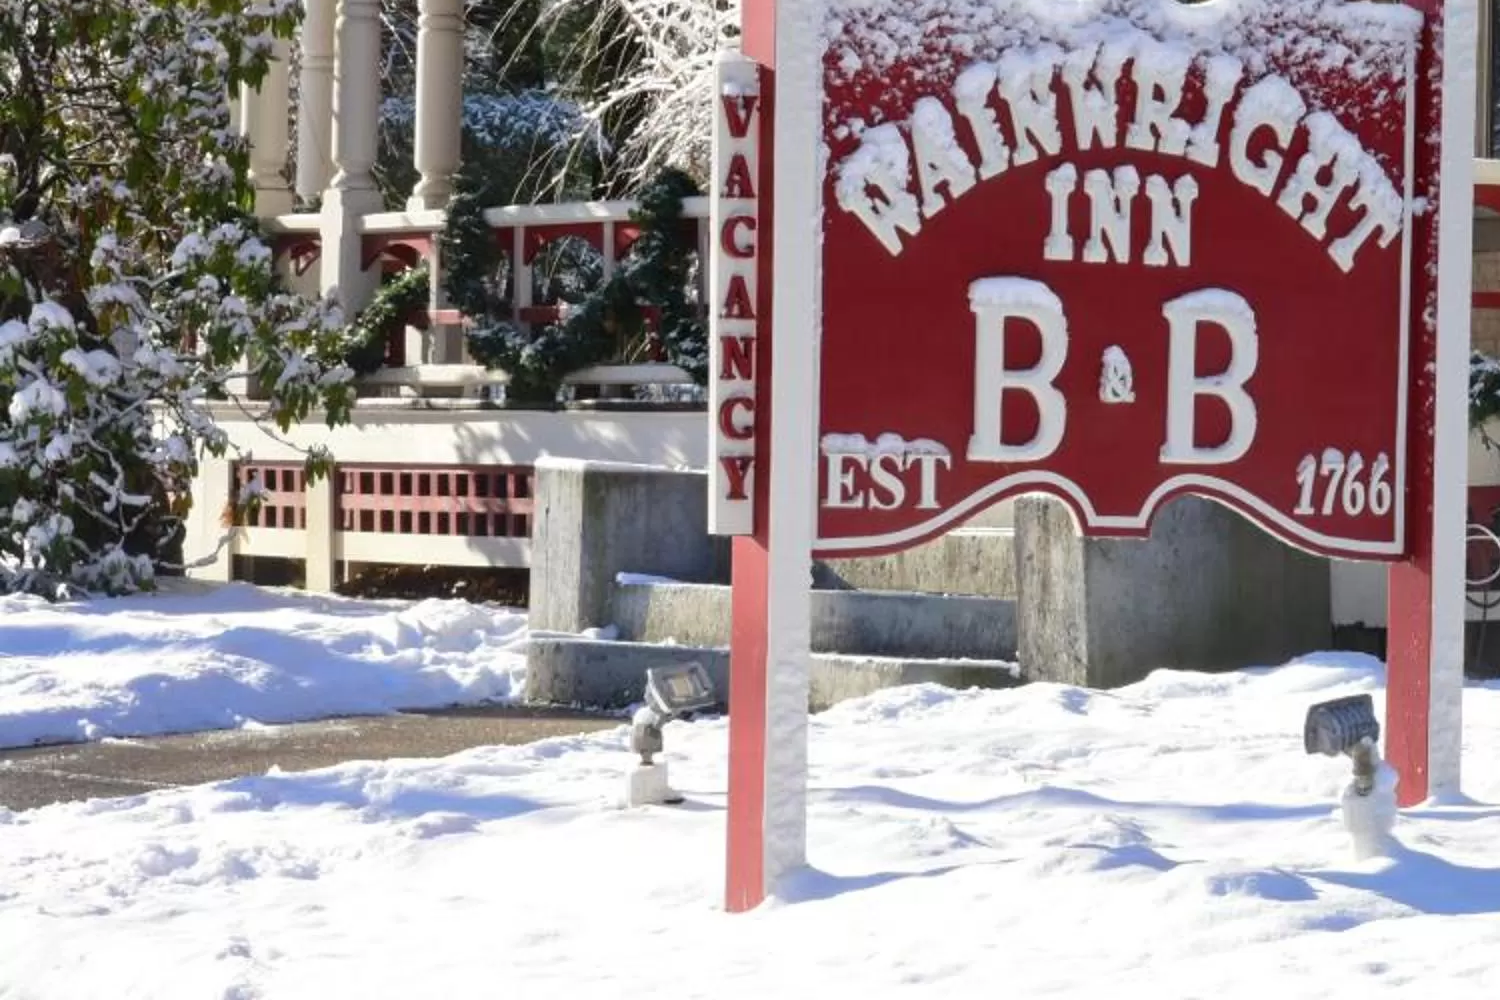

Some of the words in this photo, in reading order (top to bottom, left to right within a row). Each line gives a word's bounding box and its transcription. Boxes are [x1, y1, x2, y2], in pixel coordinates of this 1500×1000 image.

[835, 42, 1403, 274] WAINWRIGHT
[1043, 163, 1199, 267] INN
[719, 94, 758, 501] VACANCY
[966, 276, 1069, 463] B
[1099, 345, 1136, 403] &
[1159, 287, 1259, 465] B
[821, 433, 951, 510] EST
[1294, 448, 1392, 516] 1766
